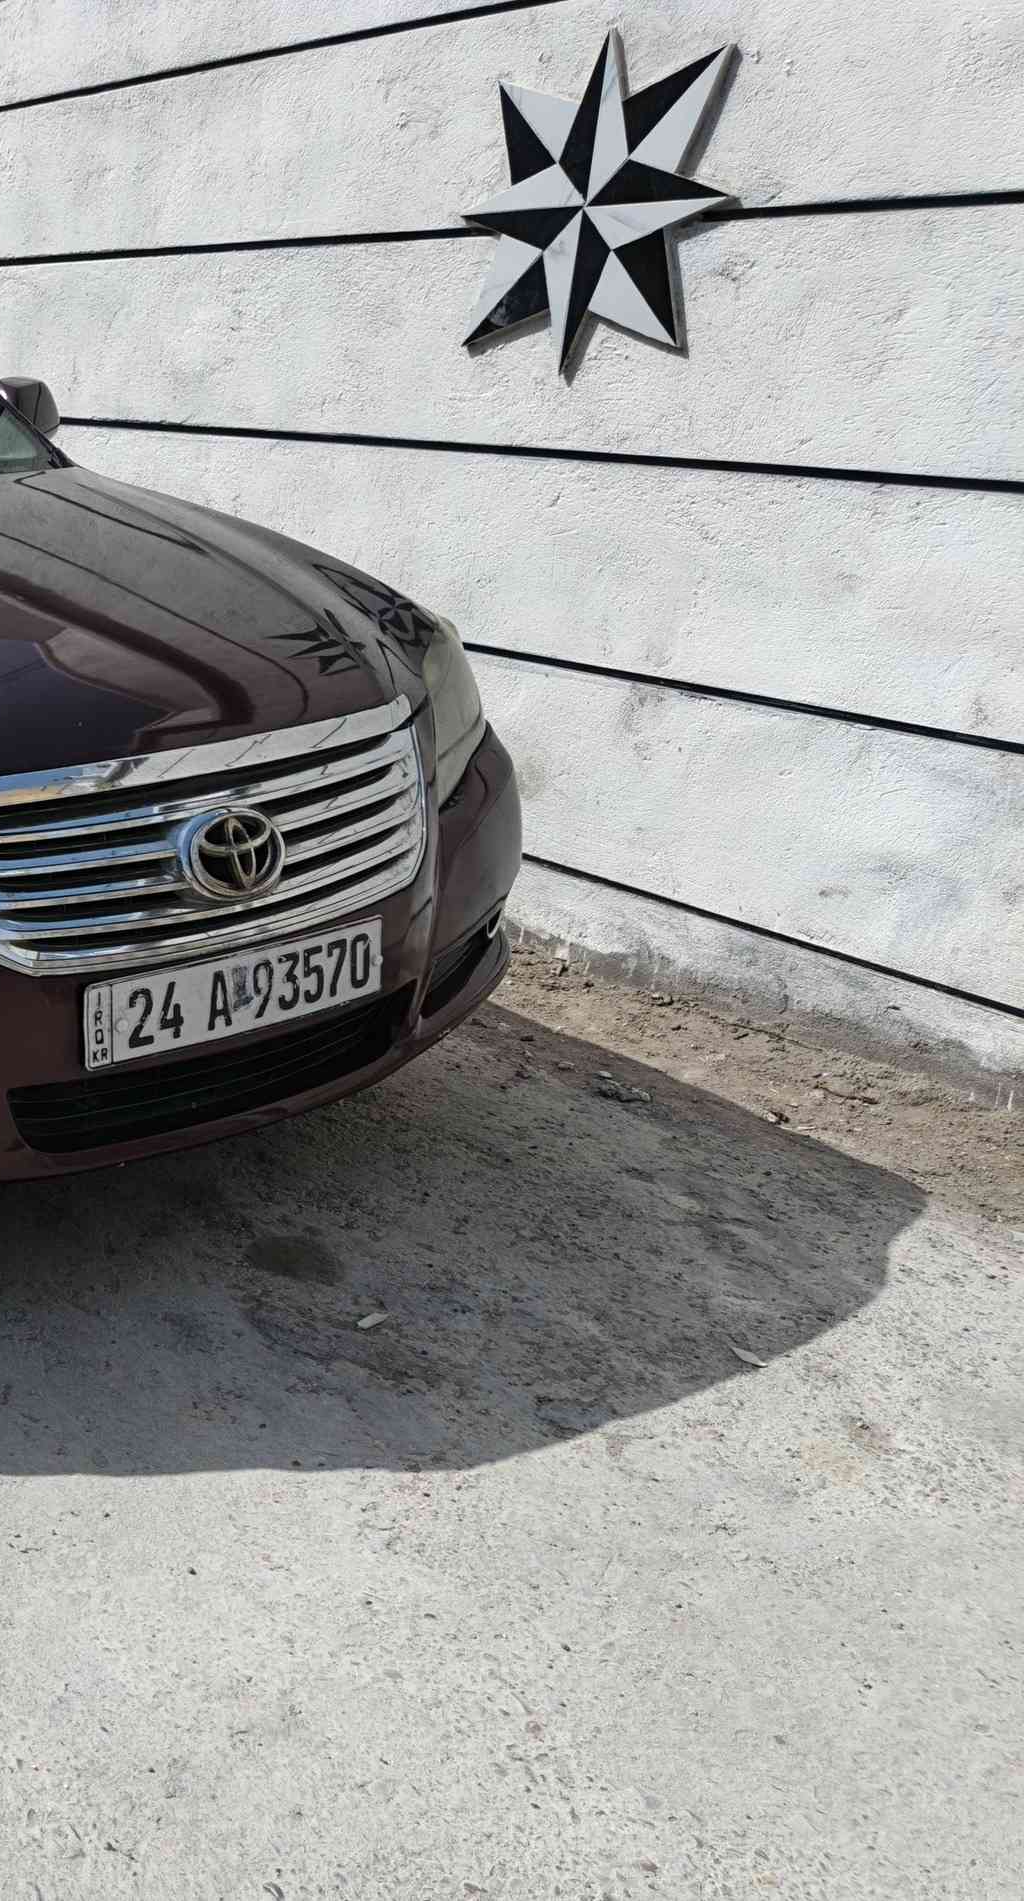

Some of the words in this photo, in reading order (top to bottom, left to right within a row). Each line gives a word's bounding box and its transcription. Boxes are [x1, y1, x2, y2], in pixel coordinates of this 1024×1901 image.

[129, 981, 184, 1048] 24
[208, 970, 232, 1031] A
[253, 933, 370, 1019] 93570
